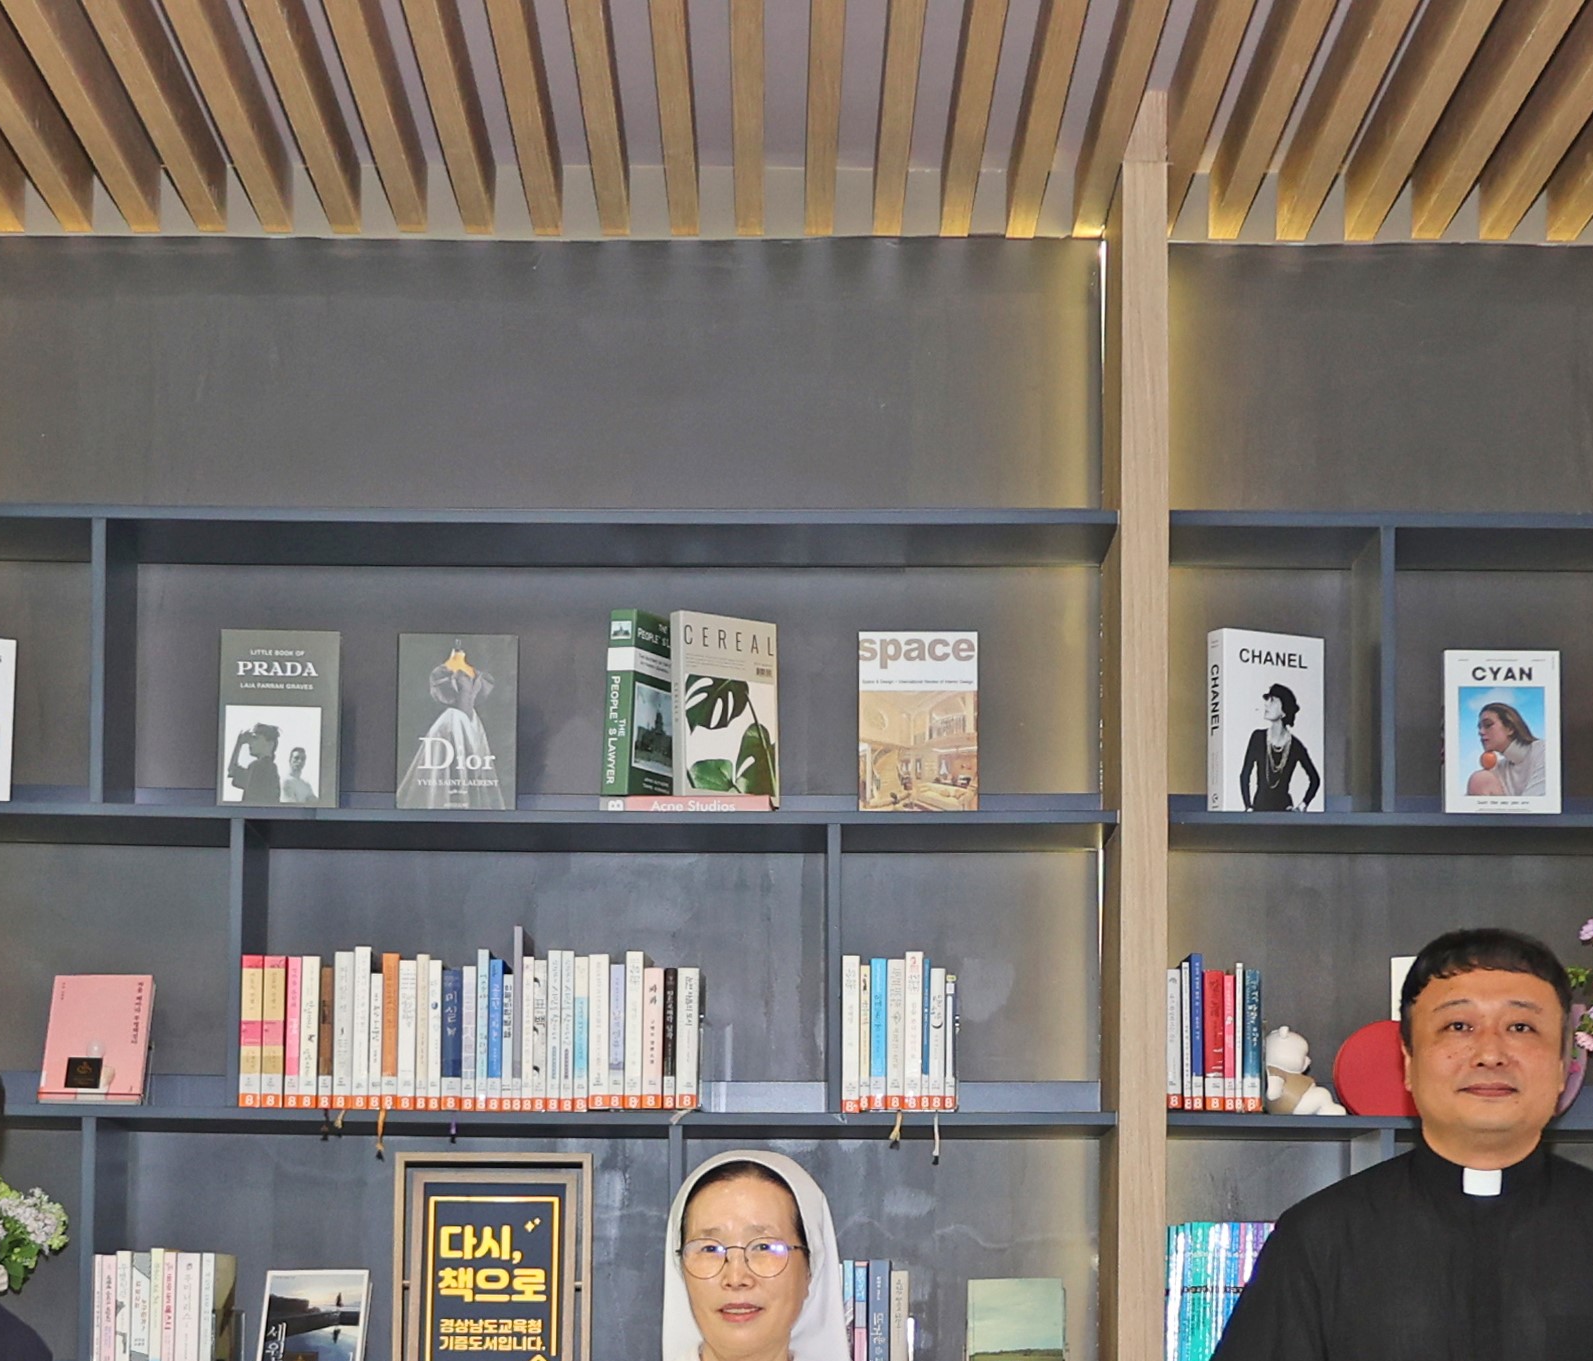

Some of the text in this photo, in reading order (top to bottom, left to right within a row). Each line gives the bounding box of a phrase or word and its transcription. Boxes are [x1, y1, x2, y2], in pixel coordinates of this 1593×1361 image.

[683, 623, 775, 657] CEREAL
[858, 638, 976, 670] space
[1238, 647, 1309, 671] CHANEL
[236, 661, 319, 677] PRADA
[1472, 666, 1533, 681] CYAN
[1210, 664, 1221, 737] CHANEL
[618, 718, 626, 737] THE
[417, 736, 497, 770] Dior
[439, 779, 460, 787] SAINT
[462, 779, 498, 787] LAURENT
[651, 799, 736, 812] Acne Studios
[265, 1095, 275, 1107] 8
[428, 1097, 439, 1111] 8
[501, 1098, 512, 1111] 8
[1169, 1095, 1179, 1109] 8
[1210, 1097, 1221, 1111] 8
[438, 1224, 524, 1265] 다시,
[437, 1267, 548, 1303] 책으로
[439, 1319, 543, 1334] 경상남도교육청
[439, 1335, 547, 1352] 기증도서입니다.
